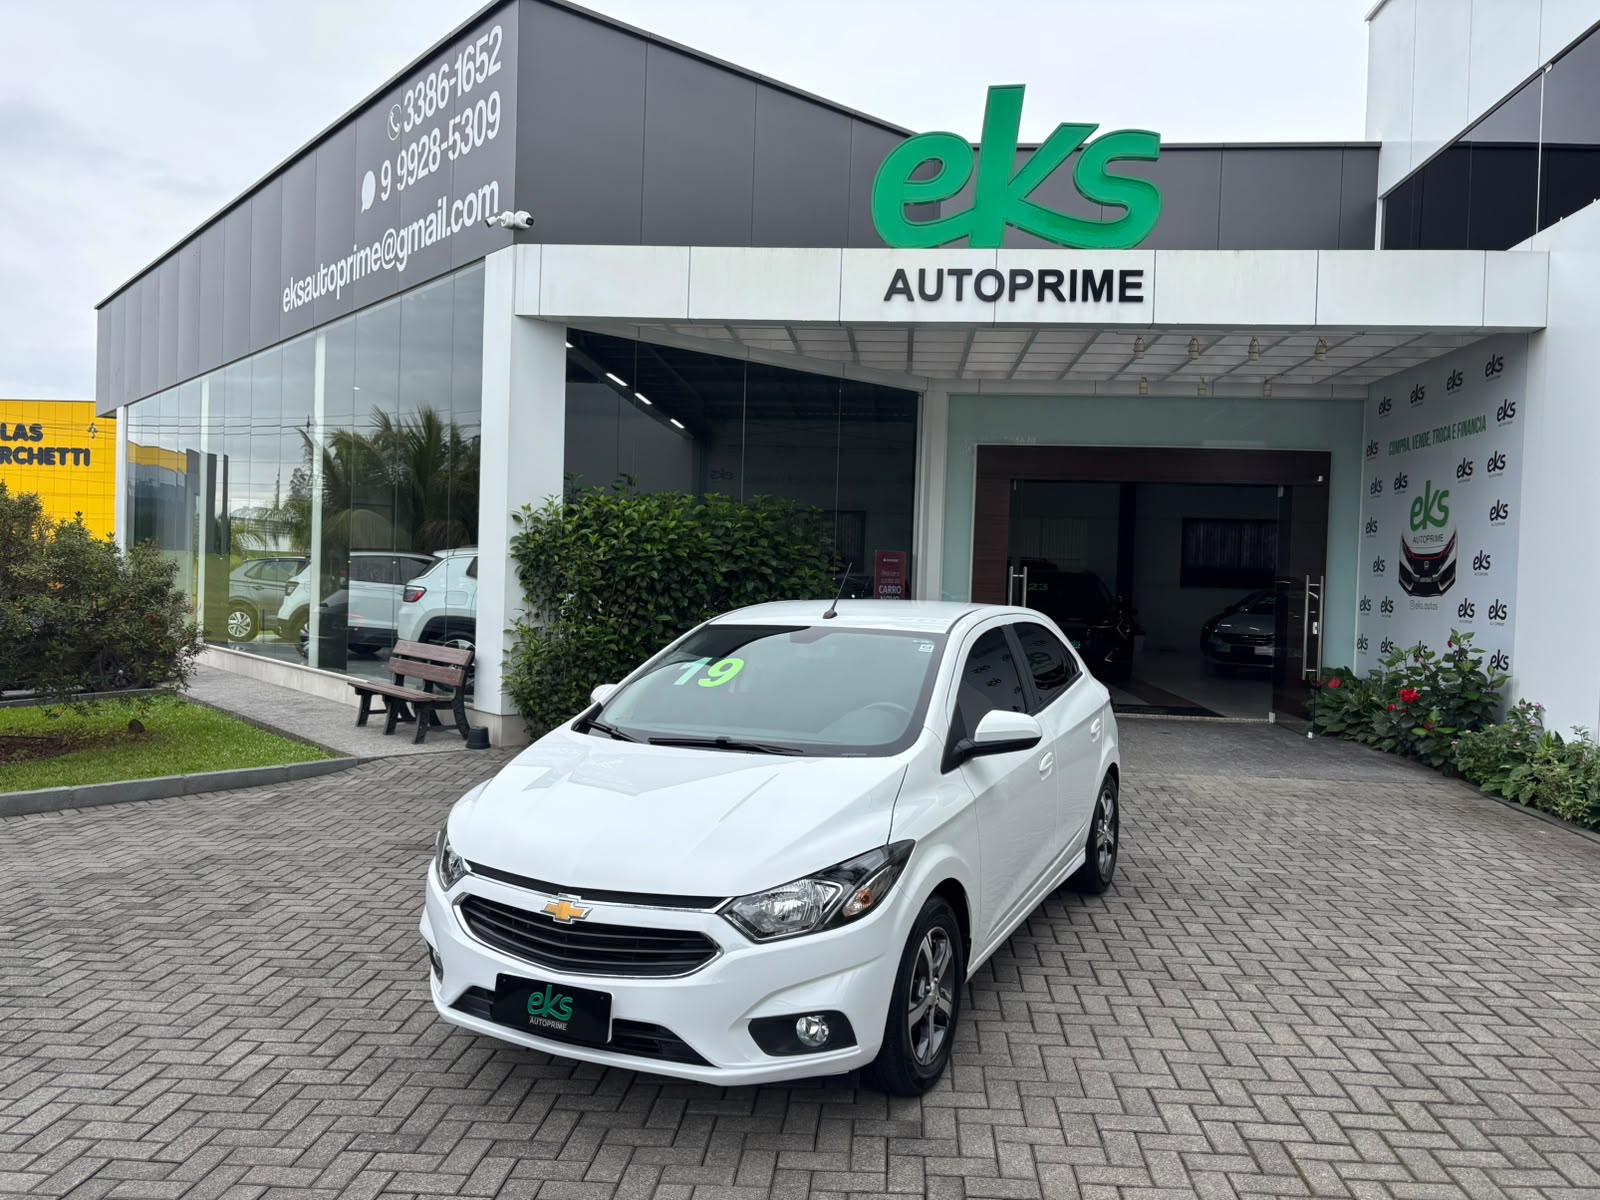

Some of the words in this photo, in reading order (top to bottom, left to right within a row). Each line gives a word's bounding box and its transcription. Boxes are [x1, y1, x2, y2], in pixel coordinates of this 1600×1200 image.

[403, 25, 503, 133] 3386-1652
[381, 160, 392, 200] 9
[396, 90, 501, 191] 9928-5309
[871, 84, 1162, 249] eks
[283, 180, 499, 313] eksautoprime@gmail.com
[883, 268, 1144, 303] AUTOPRIME
[0, 422, 43, 442] LAS
[1432, 425, 1451, 445] TROCA
[1457, 415, 1486, 438] FINANCIA
[1410, 480, 1449, 531] eks
[1413, 534, 1444, 544] AUTOPRIME
[879, 585, 901, 594] CARRO
[673, 657, 745, 688] 19
[527, 984, 574, 1021] eks
[529, 1016, 567, 1031] AUTOPRIME
